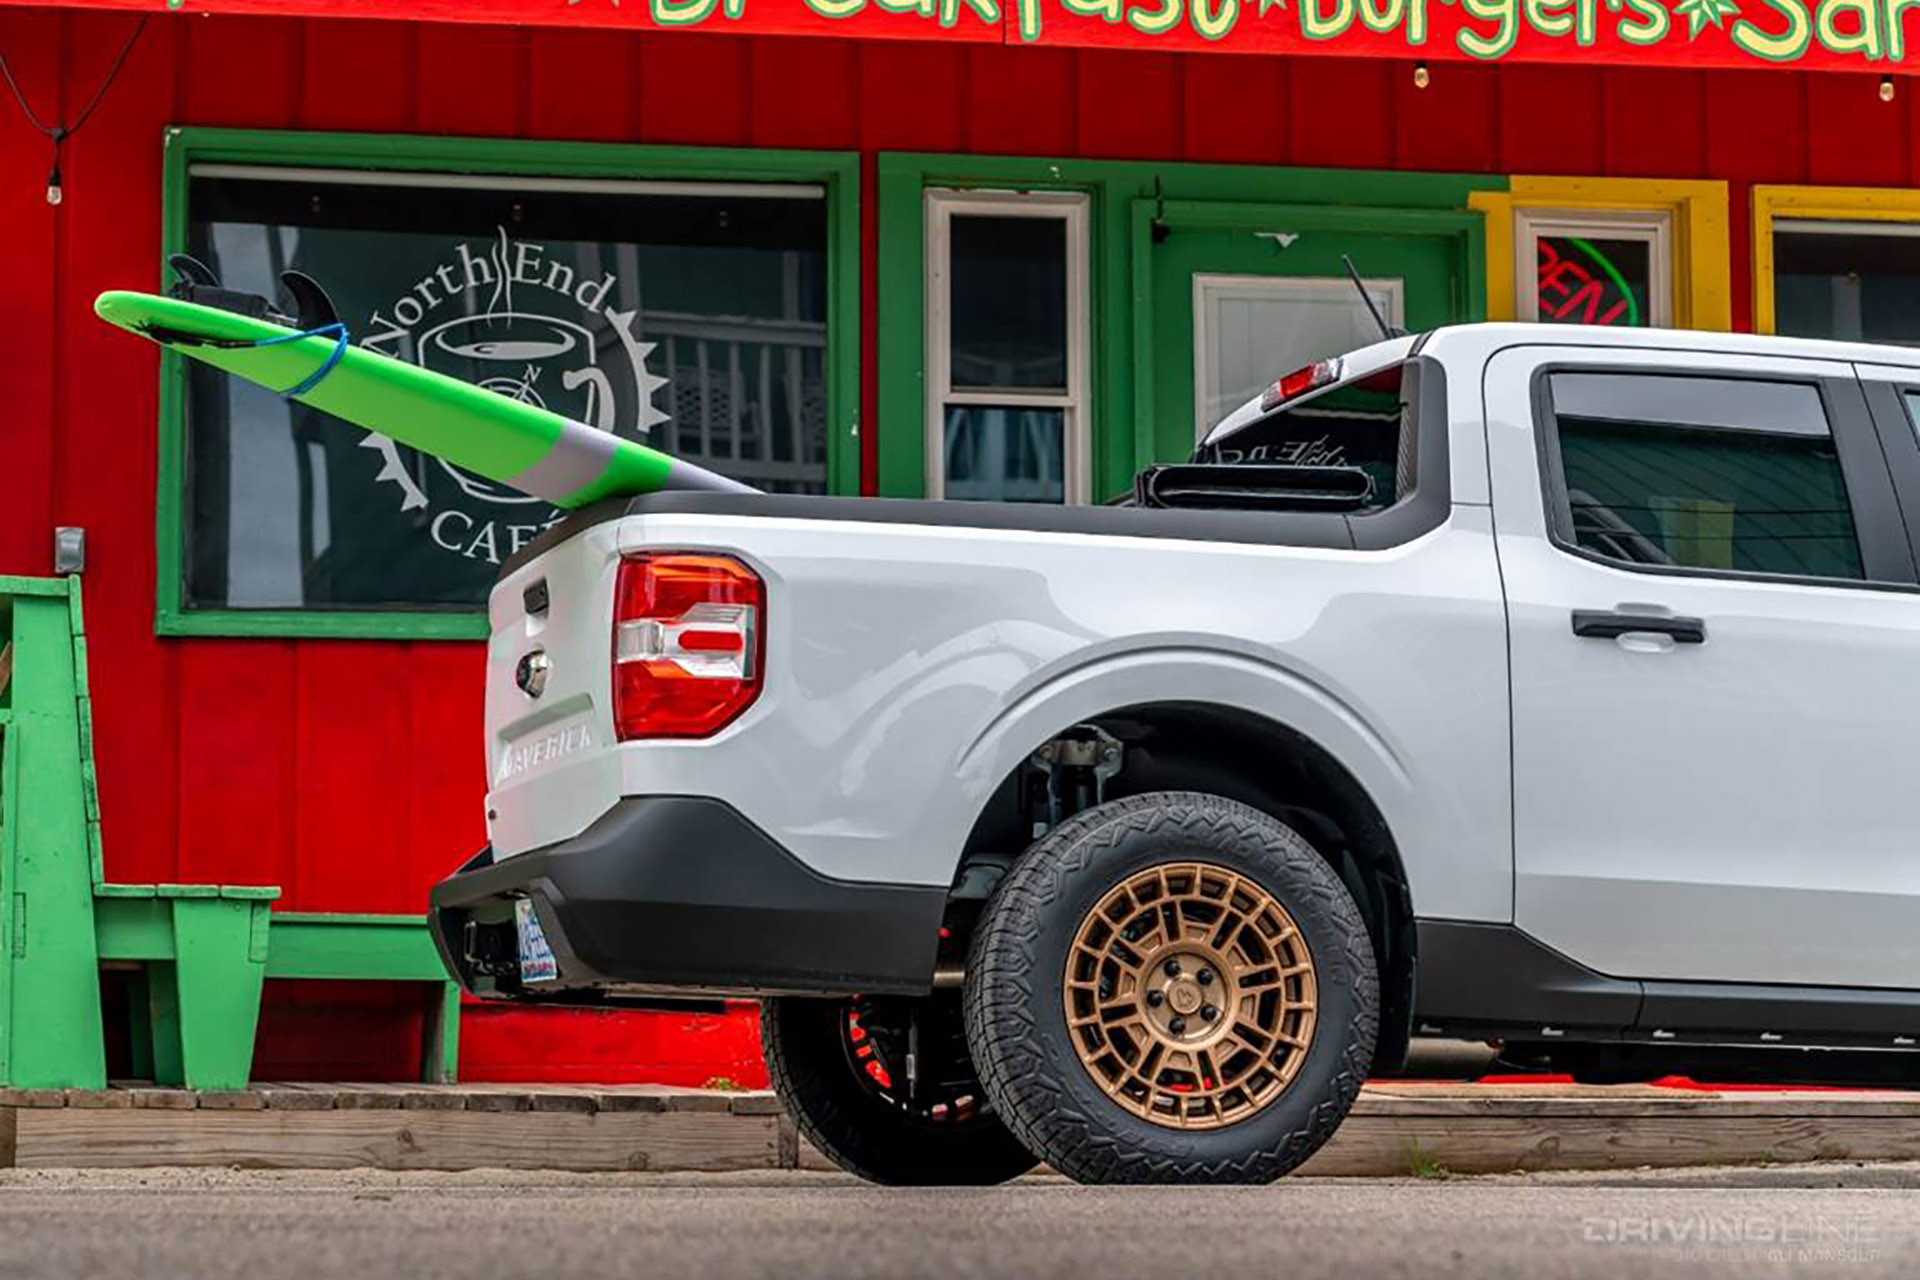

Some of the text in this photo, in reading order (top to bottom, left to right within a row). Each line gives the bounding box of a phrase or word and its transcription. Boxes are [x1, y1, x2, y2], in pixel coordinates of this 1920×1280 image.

[360, 242, 616, 358] North End
[523, 364, 542, 383] N
